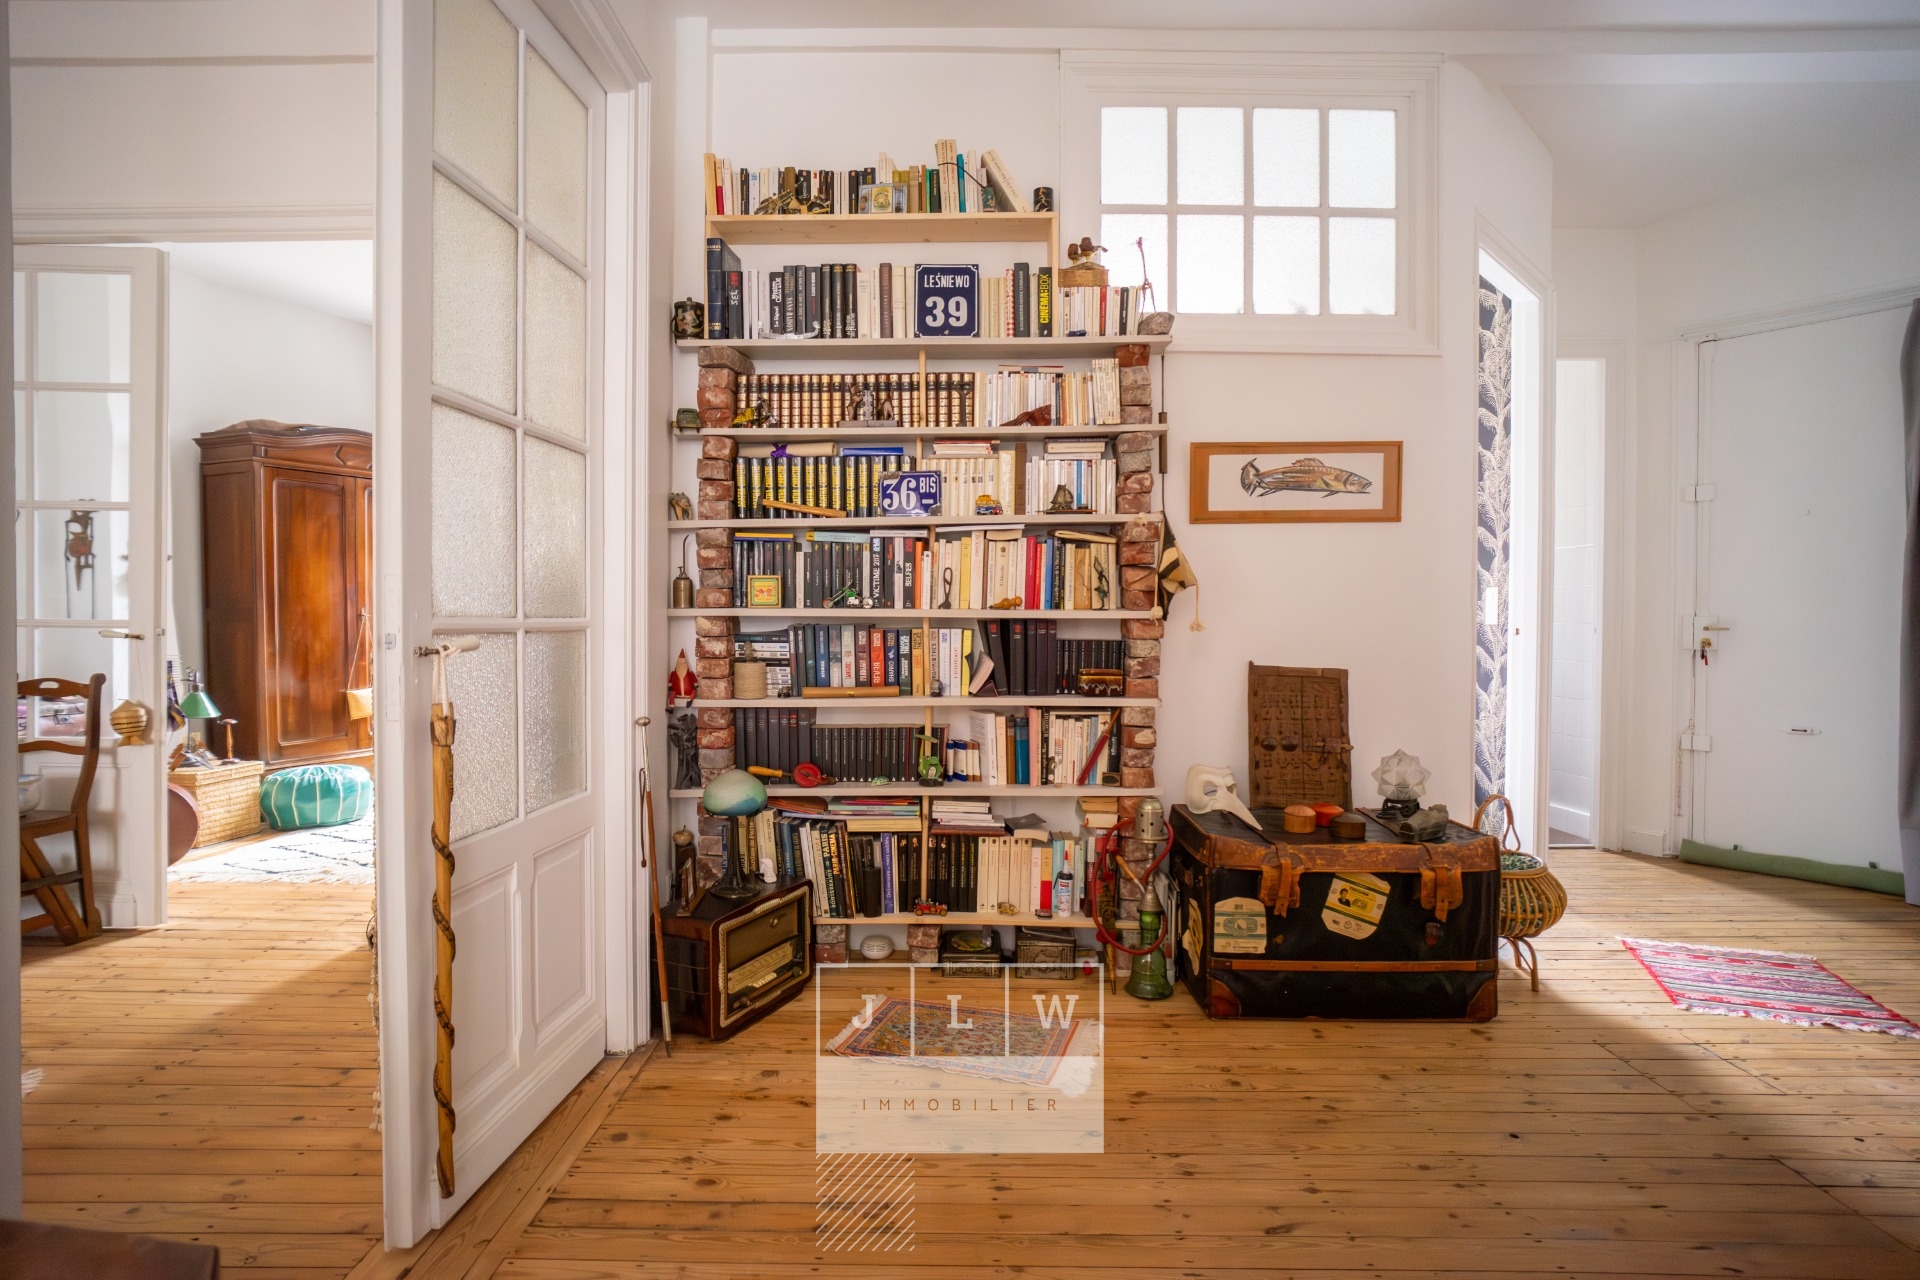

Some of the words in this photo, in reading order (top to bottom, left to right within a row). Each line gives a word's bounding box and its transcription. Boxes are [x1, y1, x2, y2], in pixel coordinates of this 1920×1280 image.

[924, 272, 970, 288] LEŚNIEWO
[925, 295, 968, 328] 39
[882, 477, 917, 511] 36
[919, 476, 937, 493] BIS
[737, 487, 746, 508] AGATHA
[818, 487, 828, 507] AGATHA
[821, 834, 830, 858] PARIS
